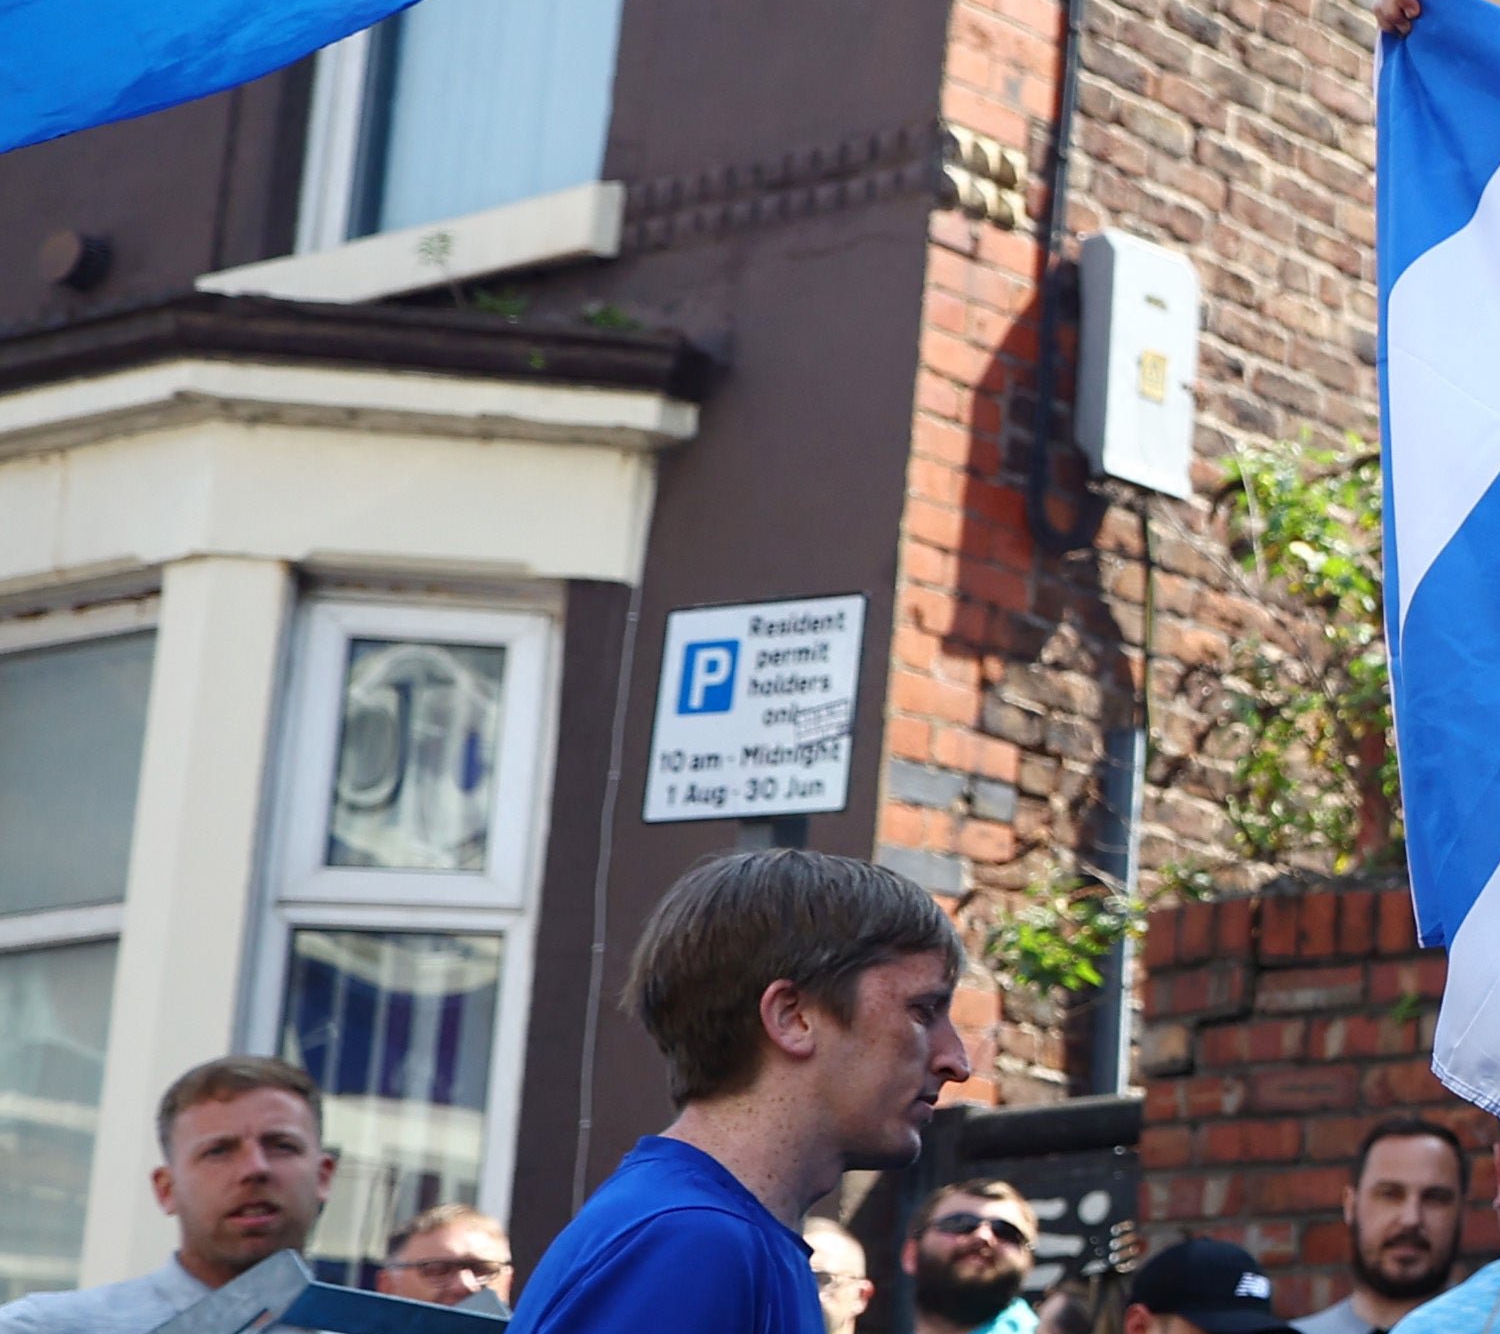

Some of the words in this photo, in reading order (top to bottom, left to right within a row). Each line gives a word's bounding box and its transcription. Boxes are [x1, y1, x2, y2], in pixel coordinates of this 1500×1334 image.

[750, 612, 845, 636] Resident
[755, 643, 829, 668] permit
[688, 646, 733, 709] P
[747, 675, 830, 696] holders
[762, 704, 799, 726] onl
[660, 751, 685, 772] 10
[690, 753, 722, 771] am
[739, 743, 841, 770] Midnight
[667, 784, 677, 804] 1
[684, 784, 728, 807] Aug
[745, 777, 778, 801] 30
[784, 777, 826, 799] Jun
